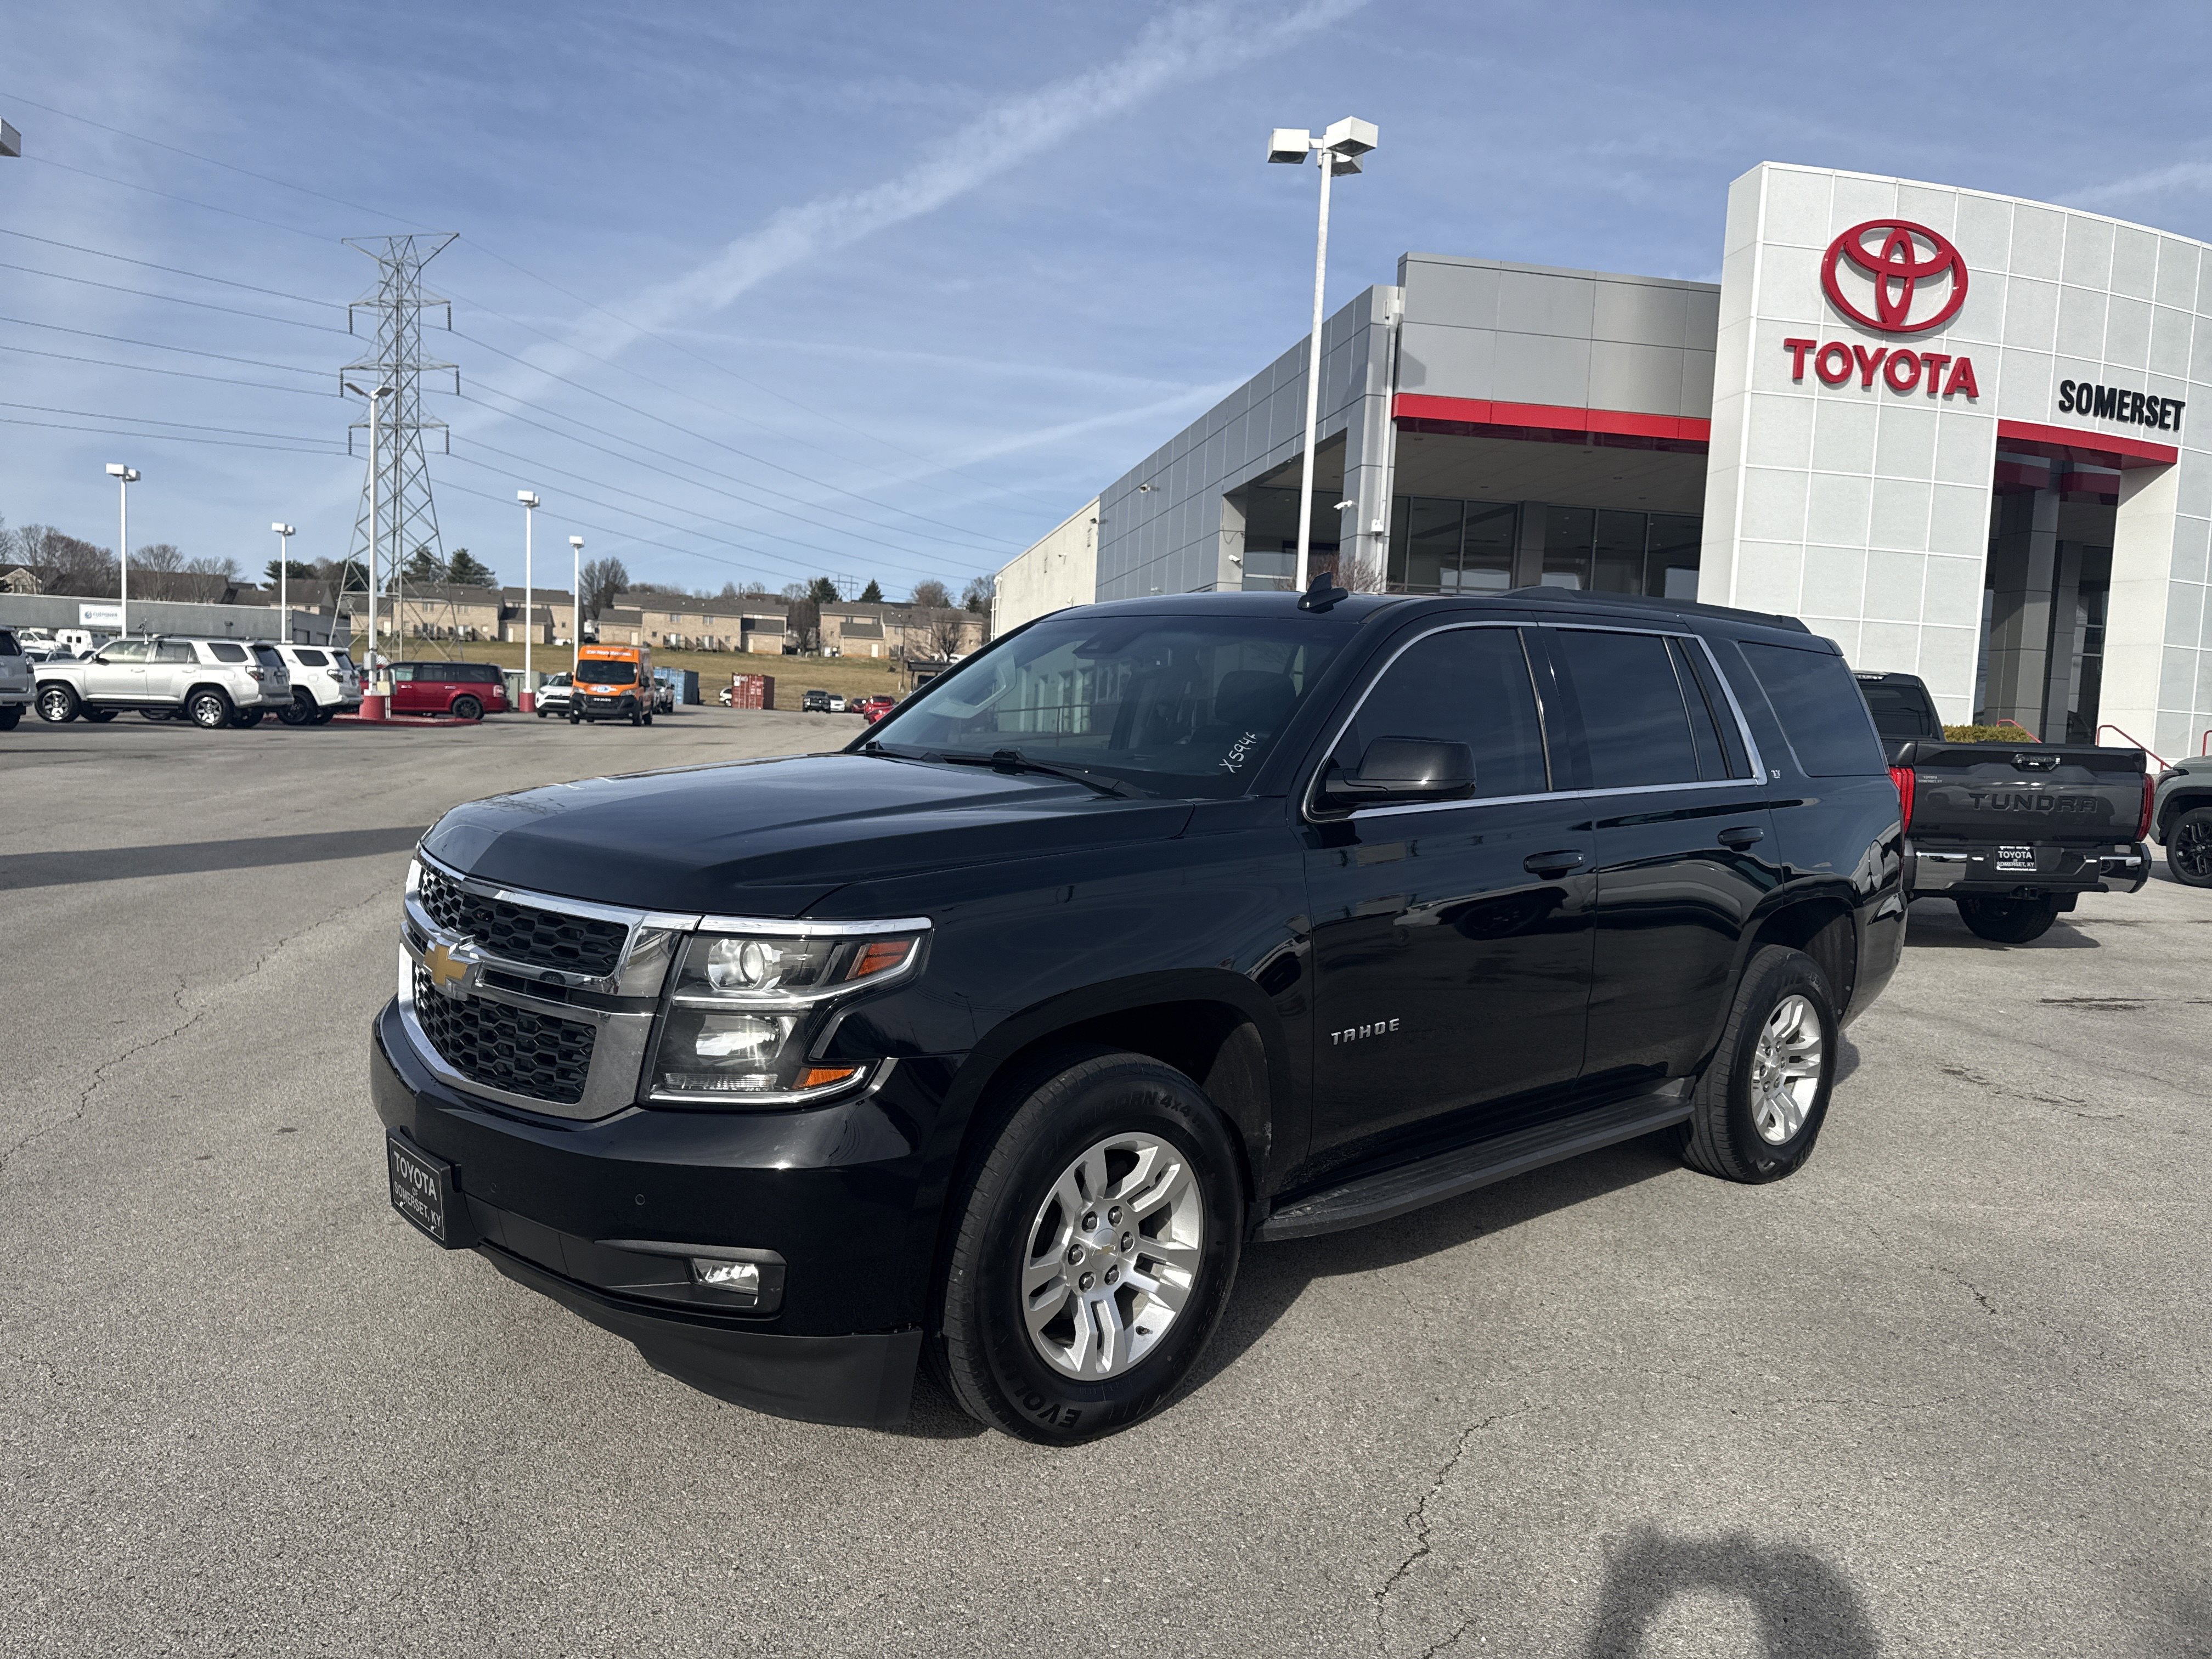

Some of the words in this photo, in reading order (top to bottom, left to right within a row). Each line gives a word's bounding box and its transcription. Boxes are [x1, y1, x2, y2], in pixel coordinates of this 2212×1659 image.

[1784, 338, 1979, 398] TOYOTA
[2059, 380, 2186, 432] SOMERSET
[1968, 793, 2098, 812] TUNDRA
[1330, 1018, 1400, 1045] TAHOE
[394, 1151, 437, 1201] TOYOTA
[412, 1187, 418, 1197] OF
[394, 1181, 430, 1222] SOMERSET,
[431, 1209, 441, 1227] KY
